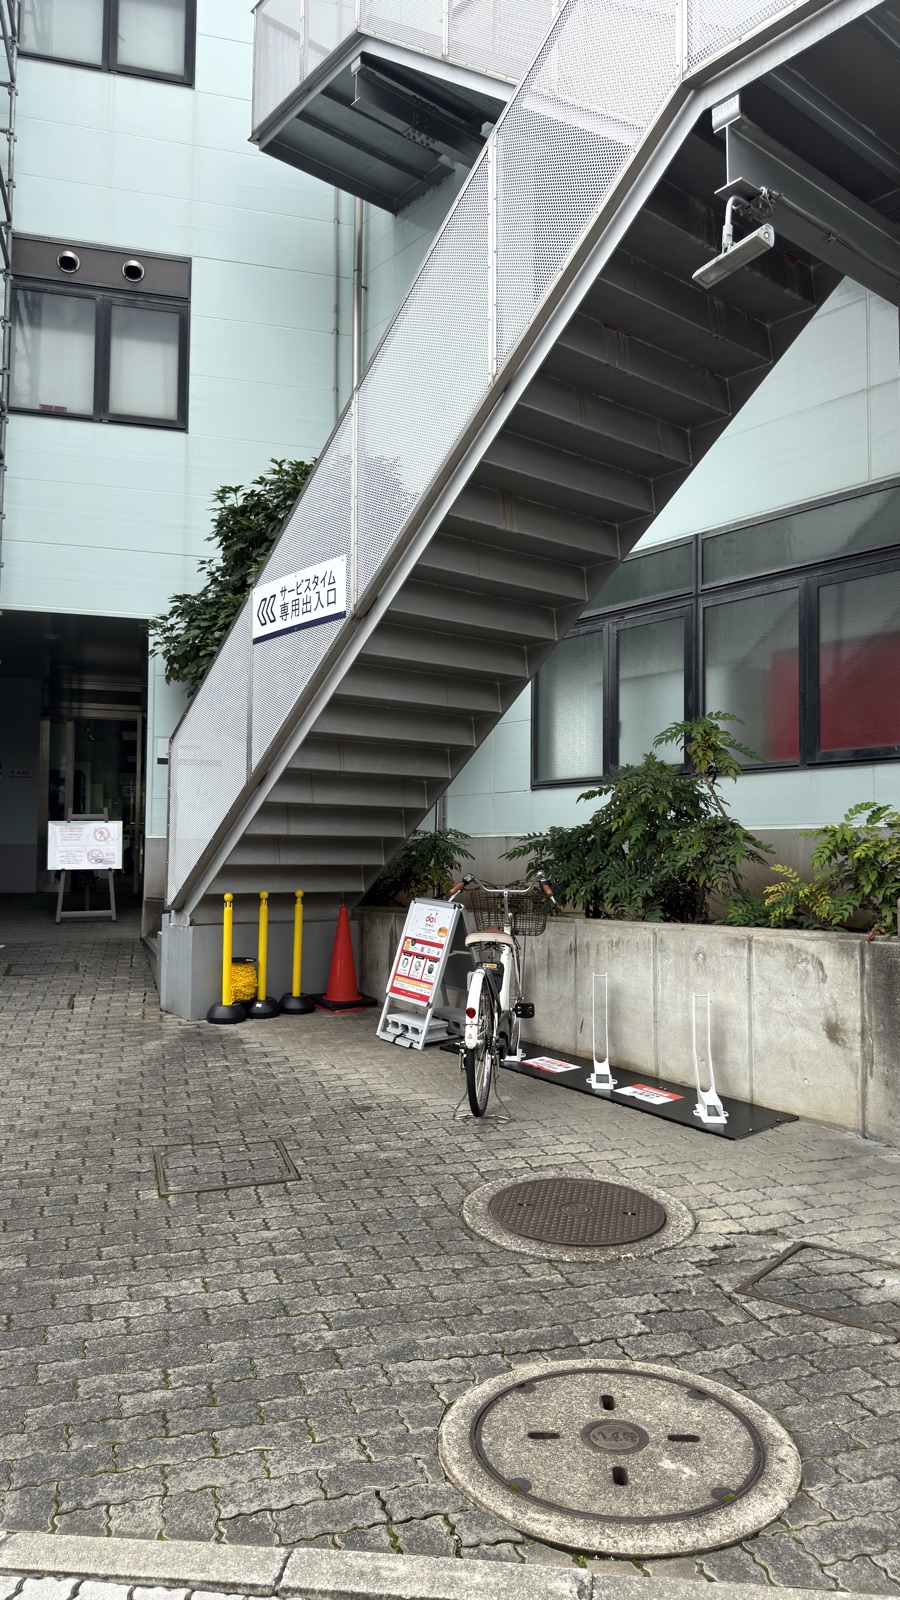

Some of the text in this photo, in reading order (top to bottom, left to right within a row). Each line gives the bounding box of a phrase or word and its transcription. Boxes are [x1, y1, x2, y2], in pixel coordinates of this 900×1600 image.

[280, 570, 336, 601] サービスタイム
[280, 588, 336, 621] 専用出入口
